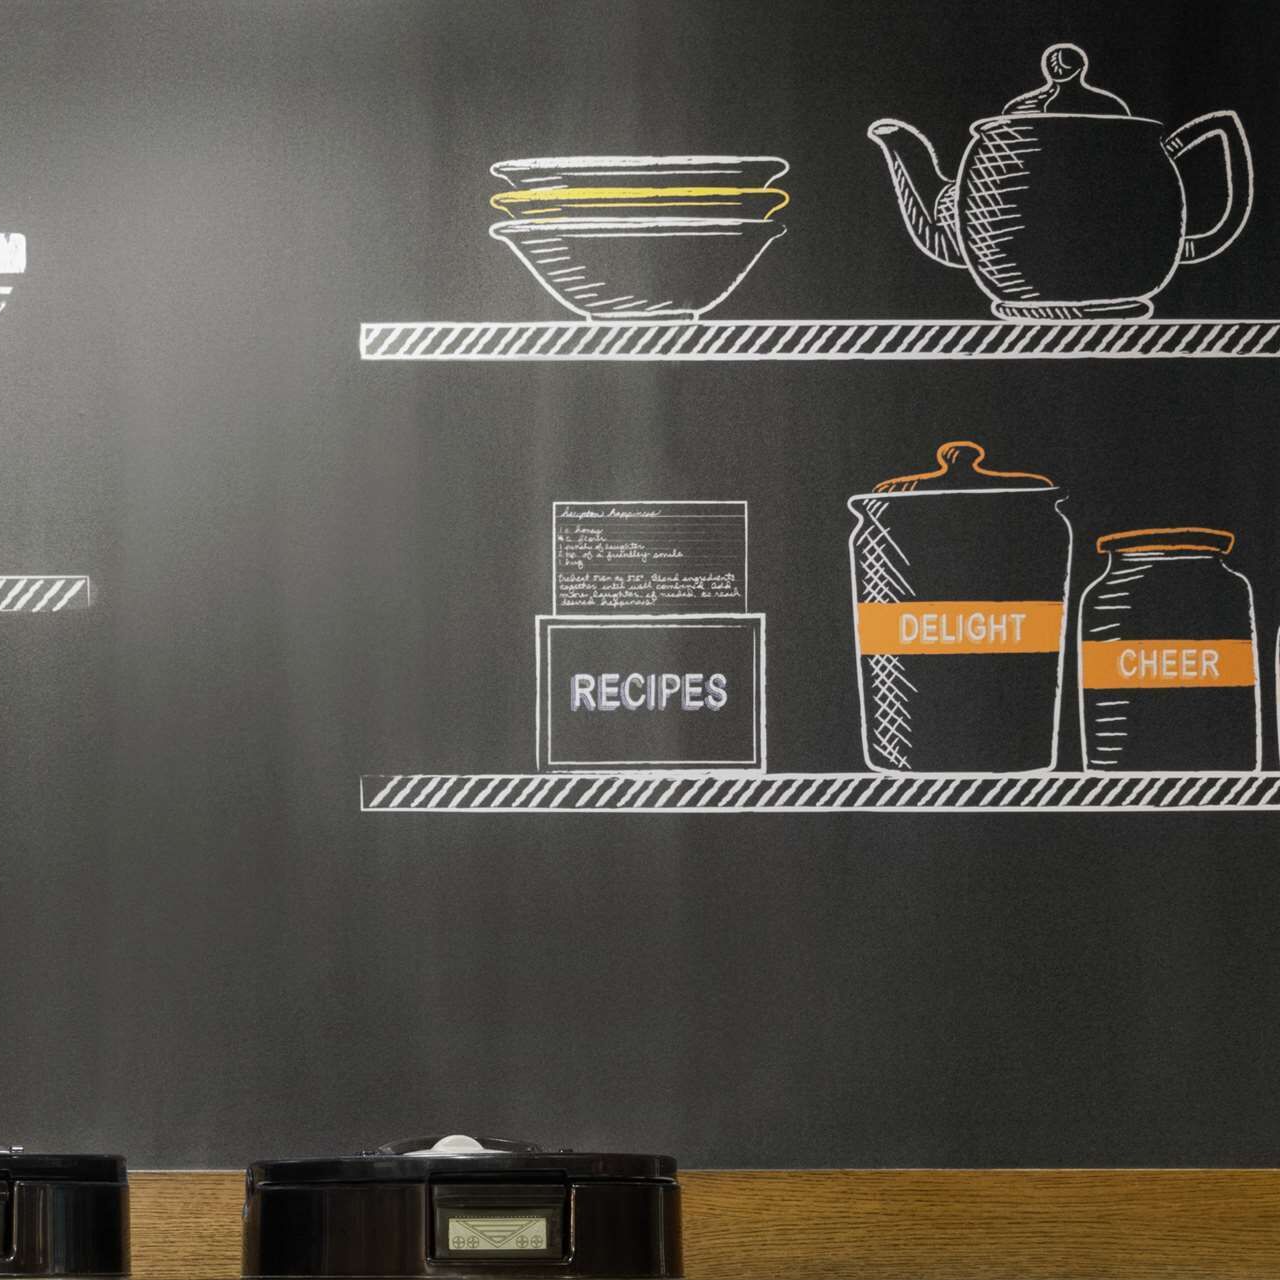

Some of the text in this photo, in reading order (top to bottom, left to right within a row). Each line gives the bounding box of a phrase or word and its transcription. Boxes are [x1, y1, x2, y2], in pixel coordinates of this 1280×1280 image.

[899, 612, 1026, 643] DELIGHT
[1119, 648, 1220, 679] CHEER
[571, 672, 728, 711] RECIPES
